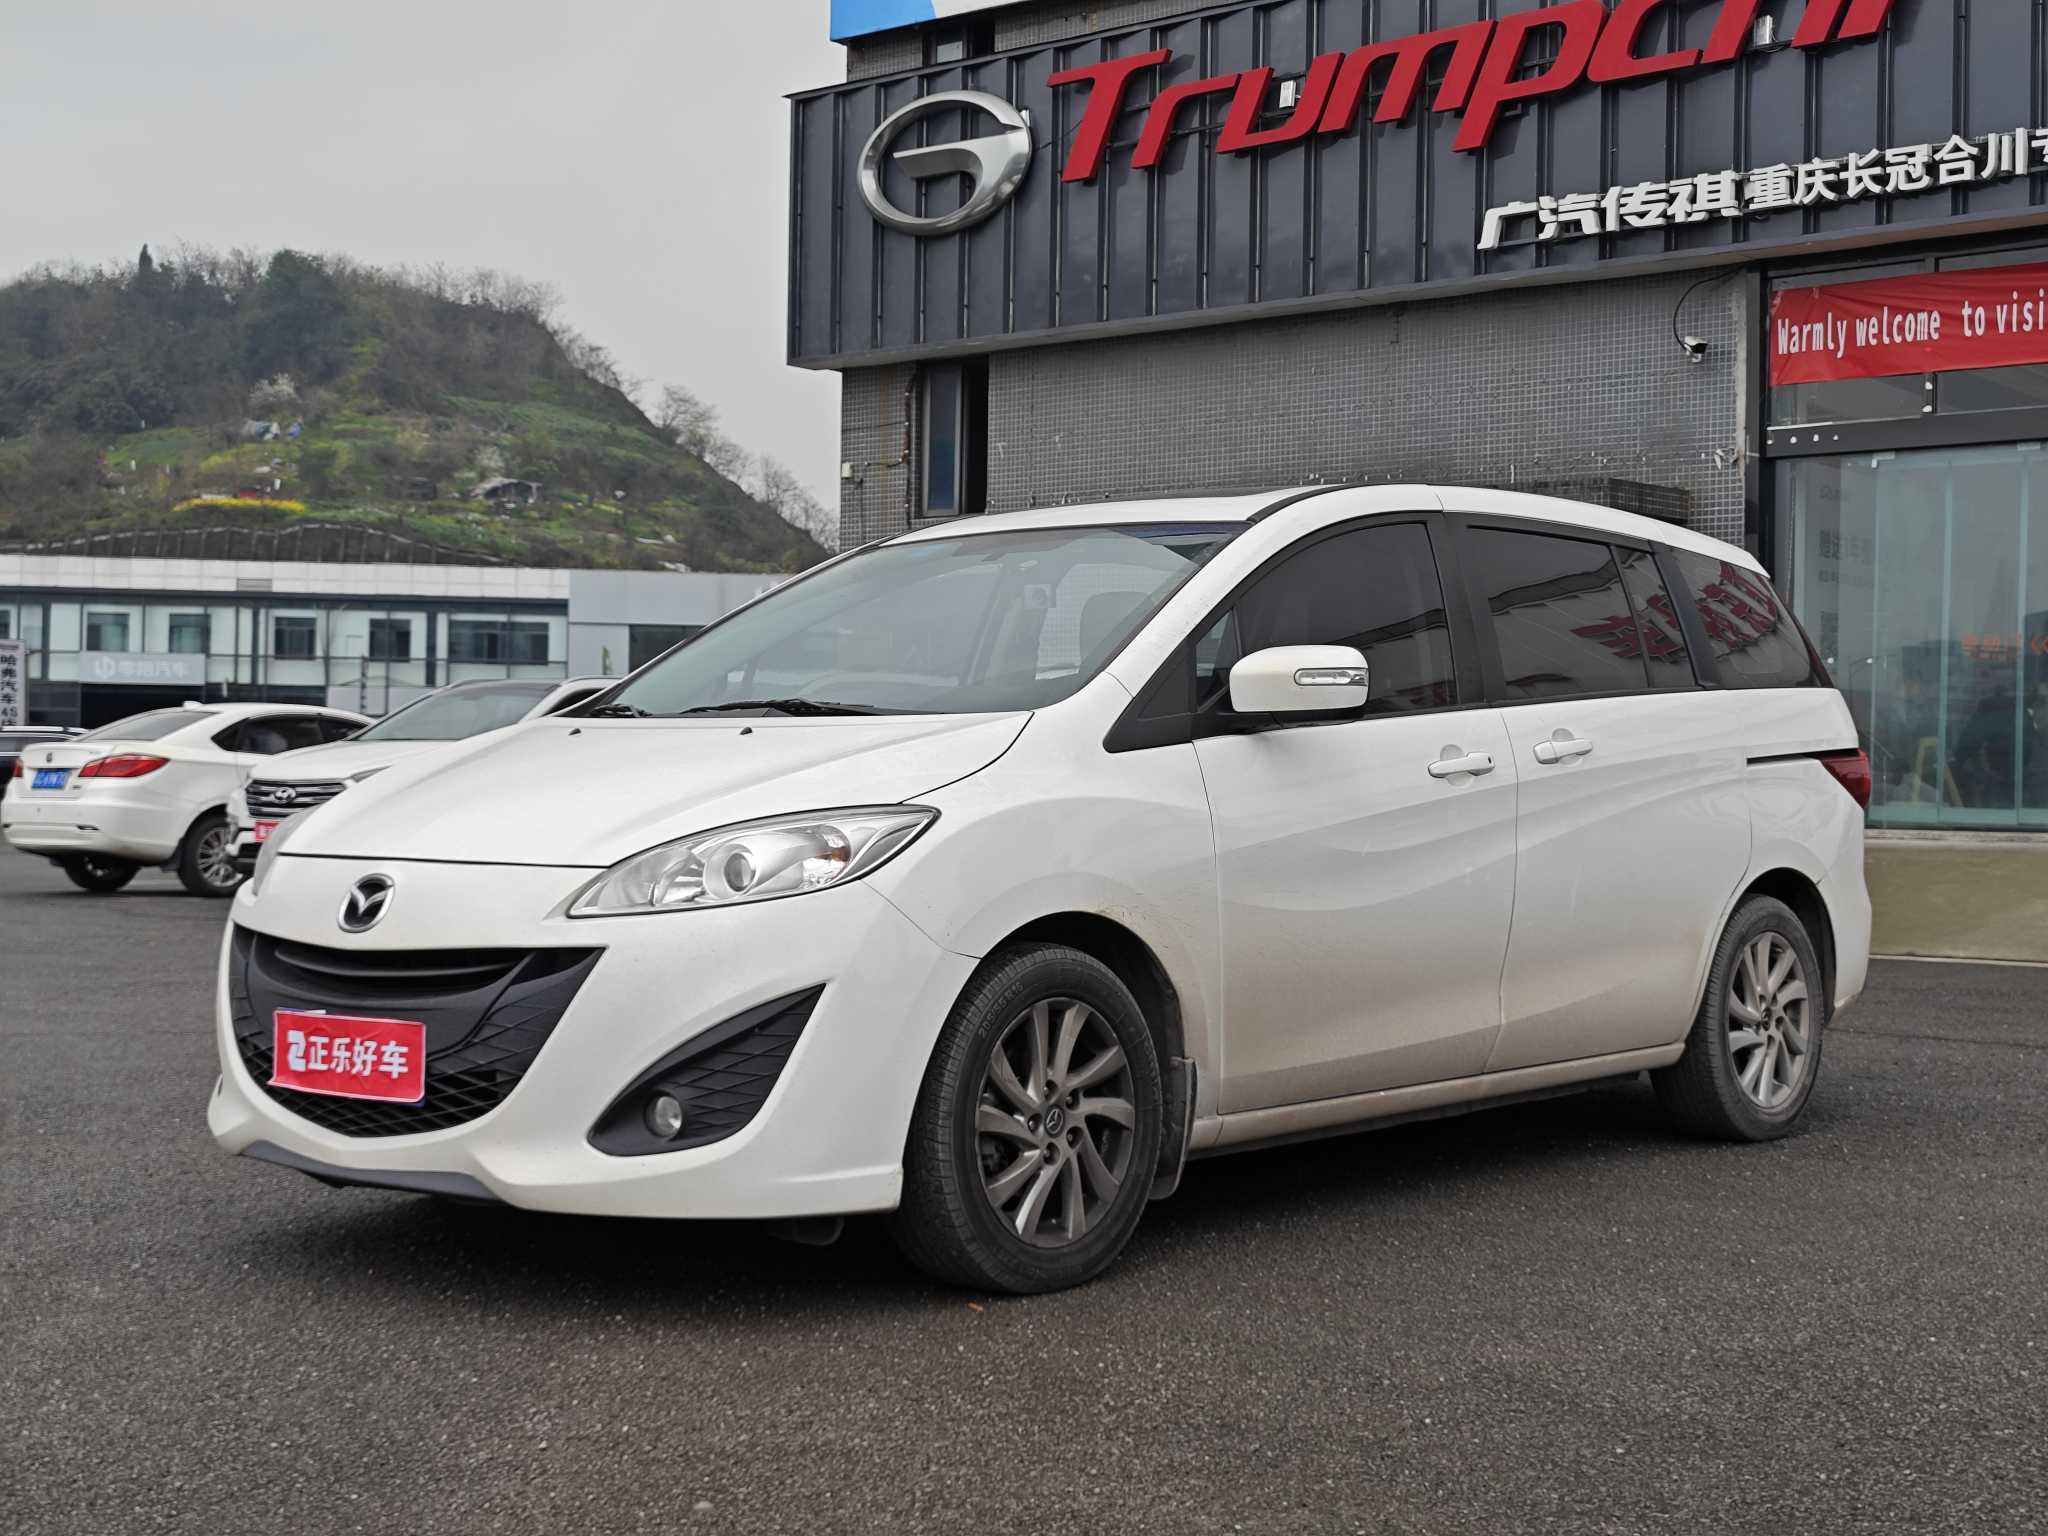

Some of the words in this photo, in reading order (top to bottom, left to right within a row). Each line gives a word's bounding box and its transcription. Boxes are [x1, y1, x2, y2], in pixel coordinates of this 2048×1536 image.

[1777, 311, 1847, 359] Warmly
[1855, 306, 1941, 347] welcome
[1961, 300, 1986, 337] to
[307, 1035, 409, 1079] 正乐好车
